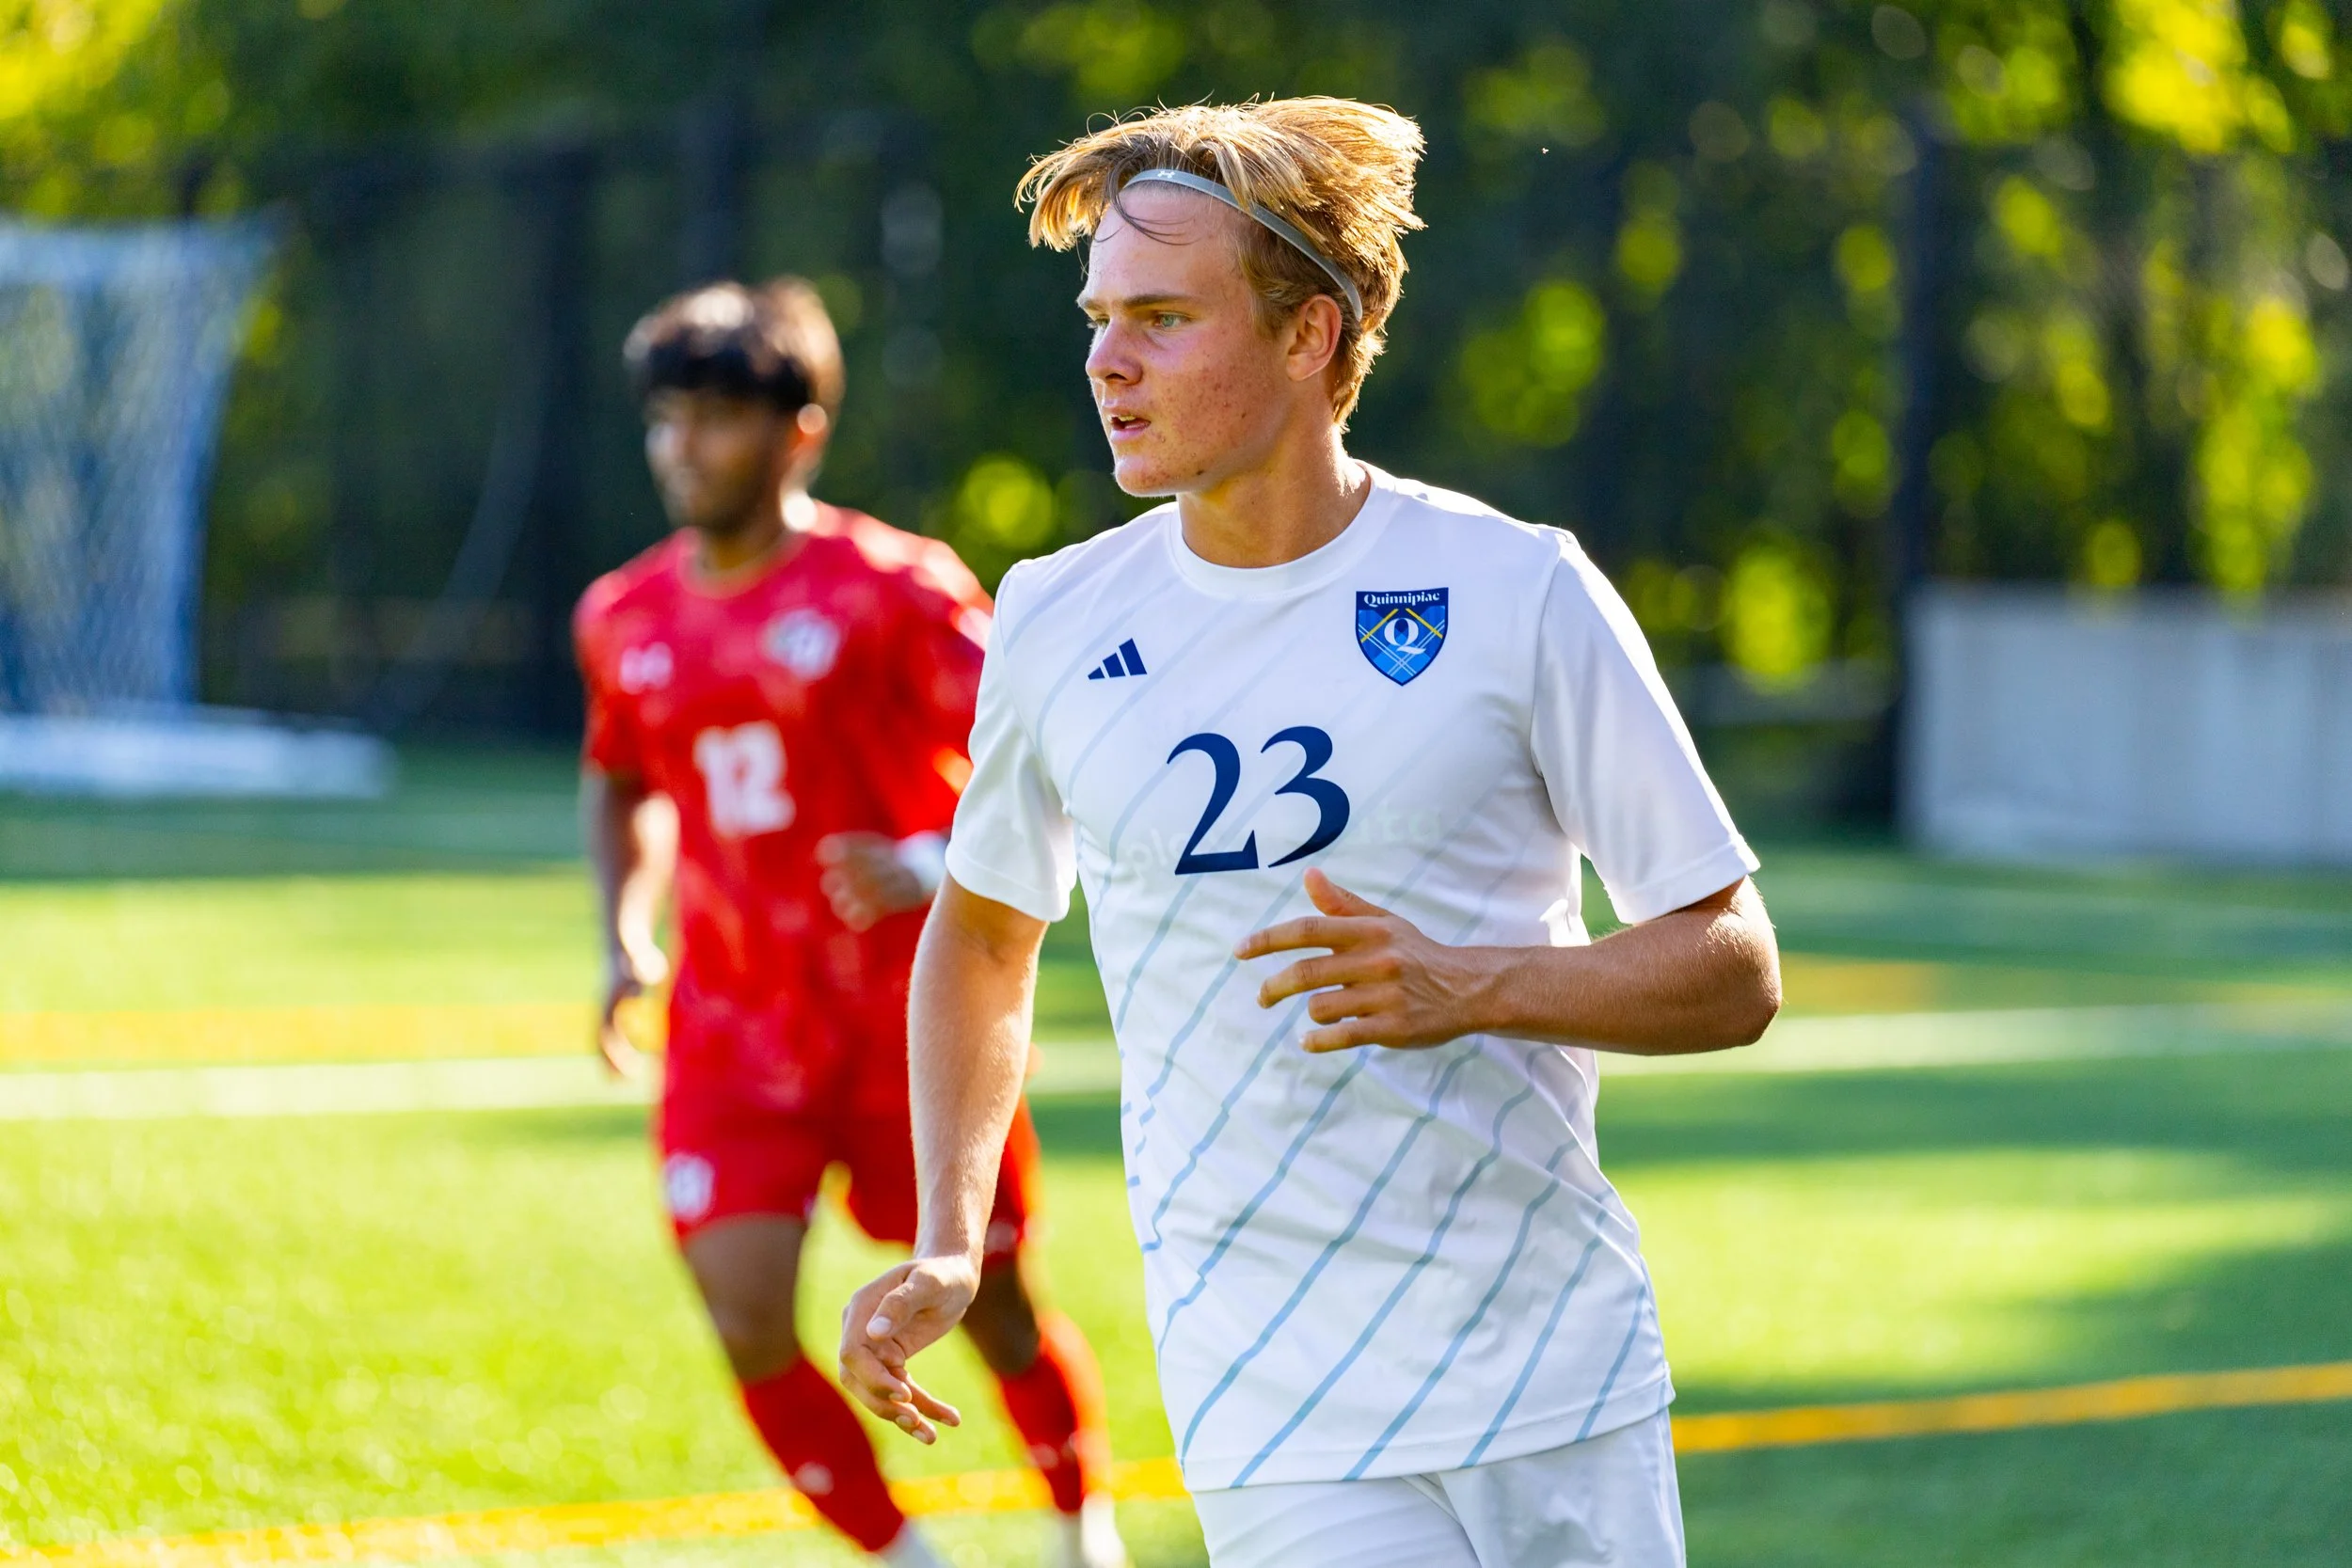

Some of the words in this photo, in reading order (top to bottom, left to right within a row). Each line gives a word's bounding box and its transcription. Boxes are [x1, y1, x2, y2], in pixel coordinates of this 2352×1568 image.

[1364, 592, 1440, 608] Quinnipiac
[1384, 617, 1426, 655] Q
[693, 721, 796, 836] 12
[1167, 725, 1350, 875] 23
